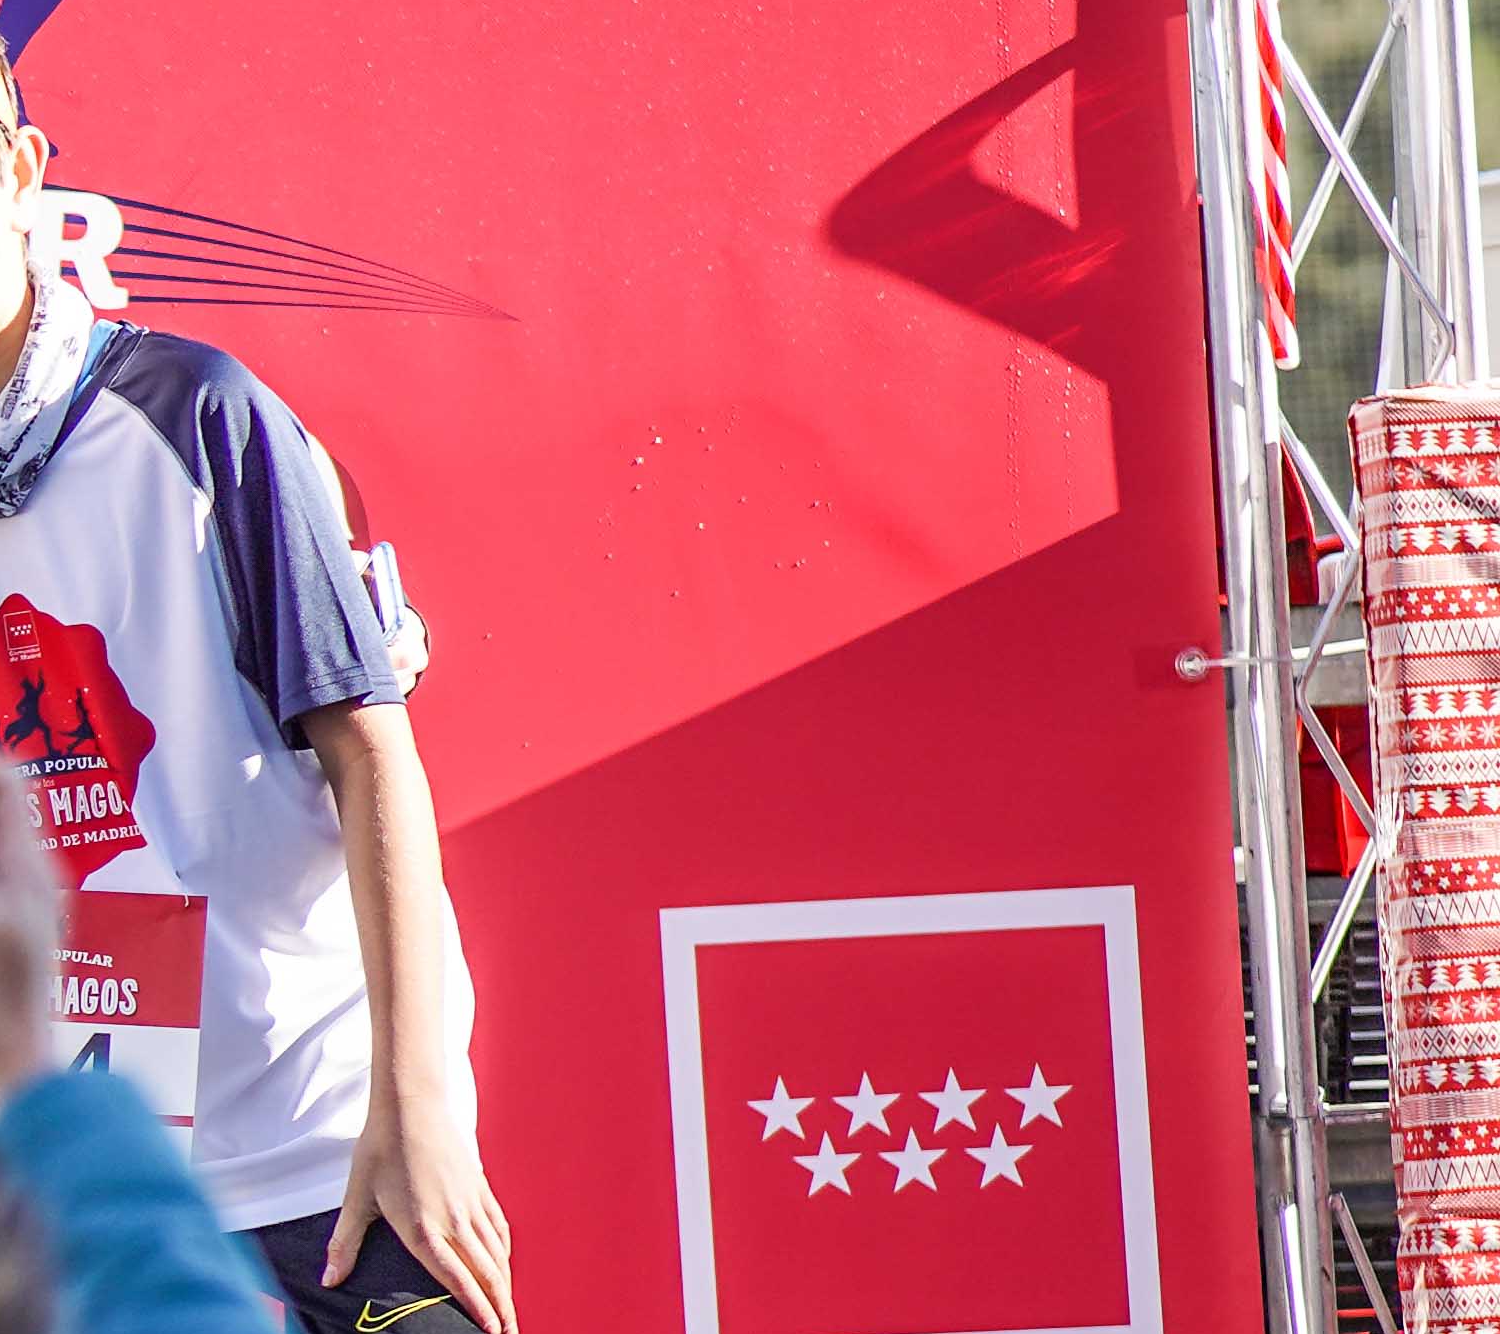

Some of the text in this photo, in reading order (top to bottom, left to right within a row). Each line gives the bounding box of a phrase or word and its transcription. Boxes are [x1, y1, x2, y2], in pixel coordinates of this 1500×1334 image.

[49, 779, 131, 827] MAGO
[62, 832, 80, 848] DE
[52, 948, 113, 969] OPULAR
